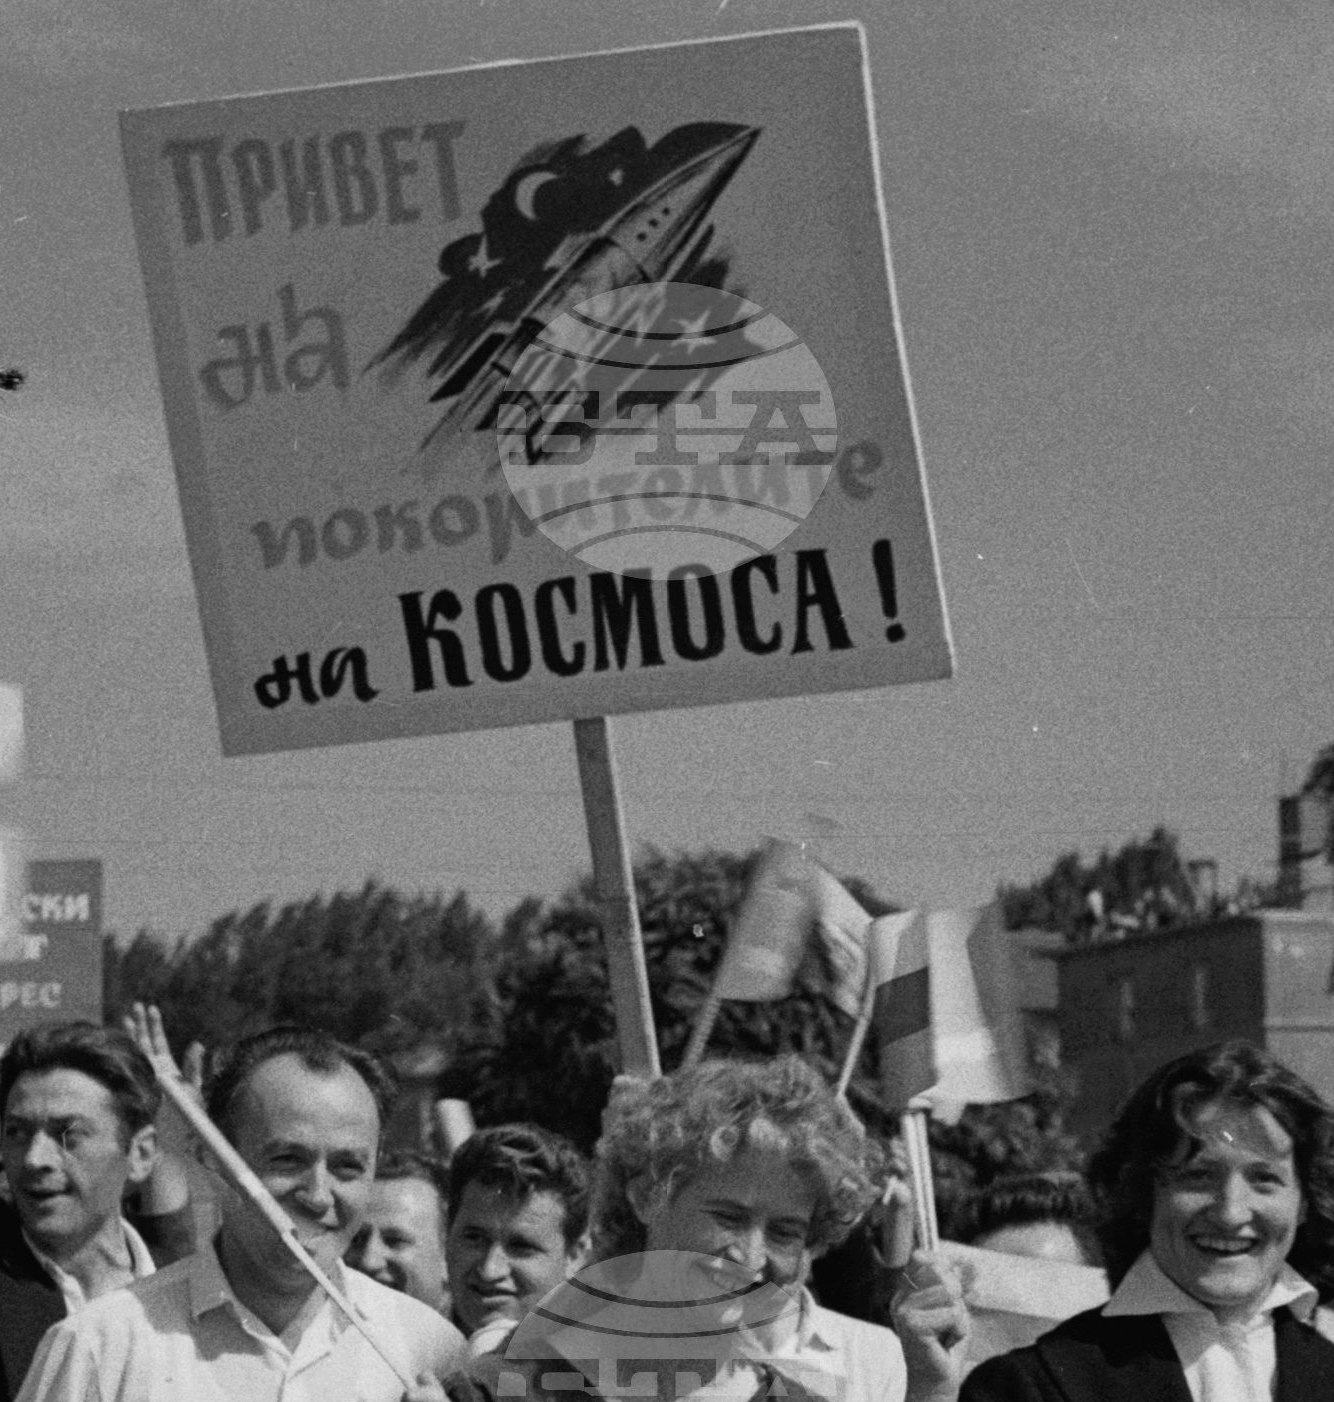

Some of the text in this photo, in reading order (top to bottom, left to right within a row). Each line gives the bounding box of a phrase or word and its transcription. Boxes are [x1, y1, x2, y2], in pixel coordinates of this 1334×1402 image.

[162, 120, 466, 247] ПРИВЕТ
[199, 281, 350, 408] на
[252, 645, 380, 710] на
